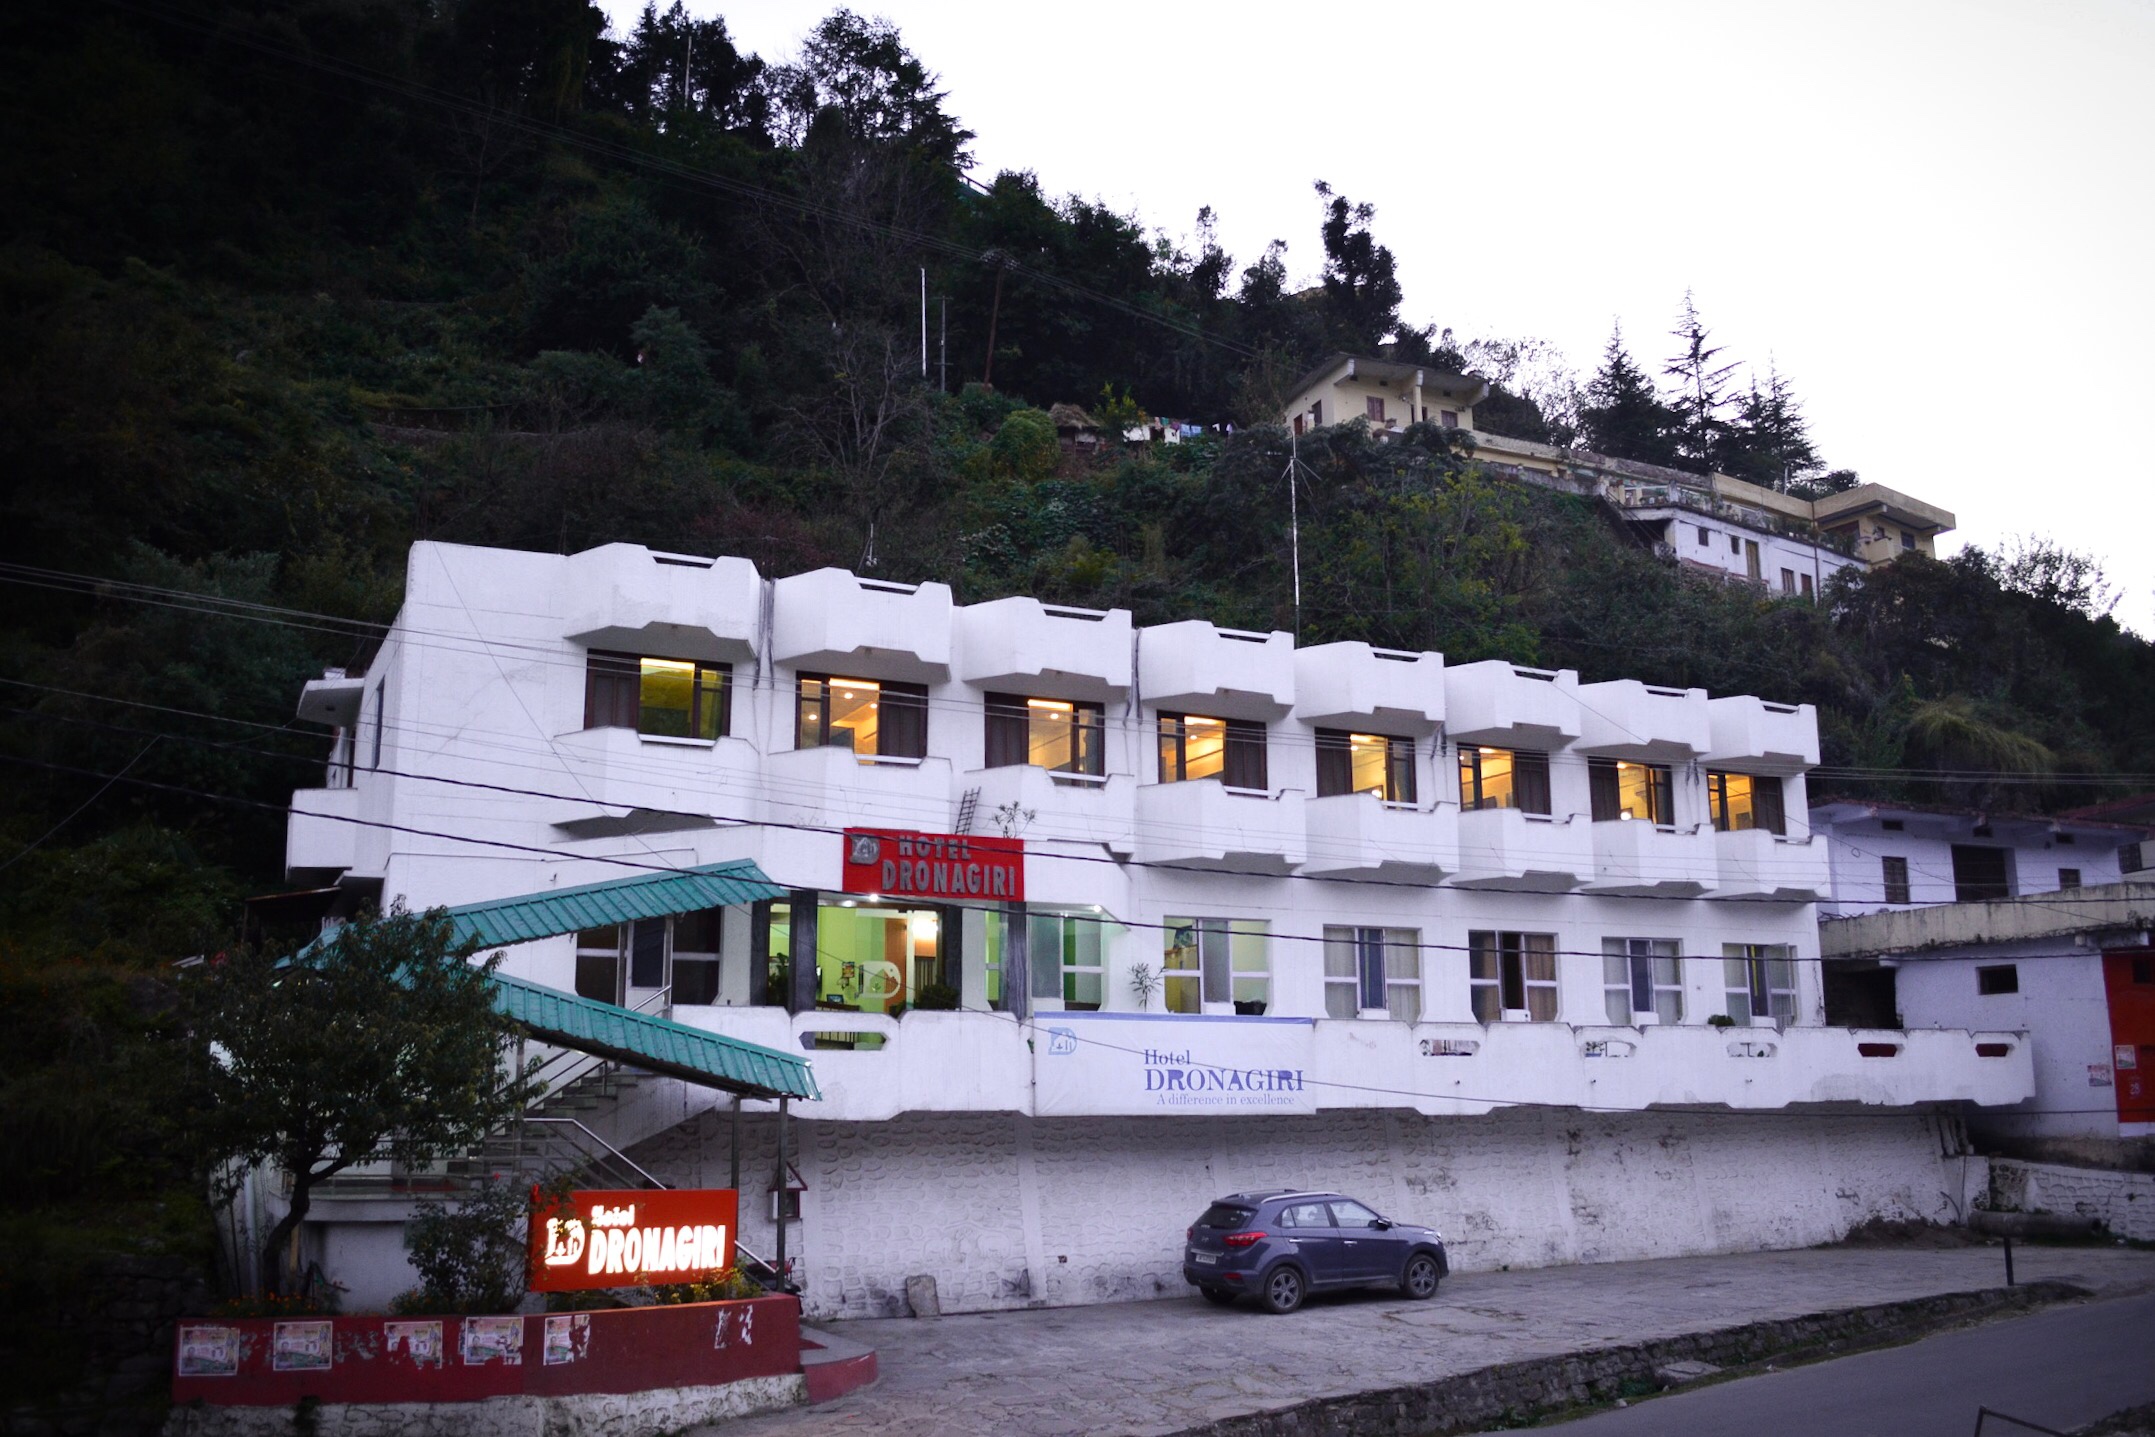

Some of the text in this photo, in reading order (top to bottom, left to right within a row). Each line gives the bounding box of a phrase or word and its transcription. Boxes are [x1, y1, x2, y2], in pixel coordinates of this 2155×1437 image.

[899, 835, 971, 860] HOTEL
[881, 860, 1015, 896] DRONAGIRI
[1144, 1049, 1190, 1065] Hotel
[1144, 1068, 1304, 1091] DRONAGIRI
[1157, 1094, 1294, 1105] A difference in excellence
[588, 1225, 726, 1275] DRONAGIRI
